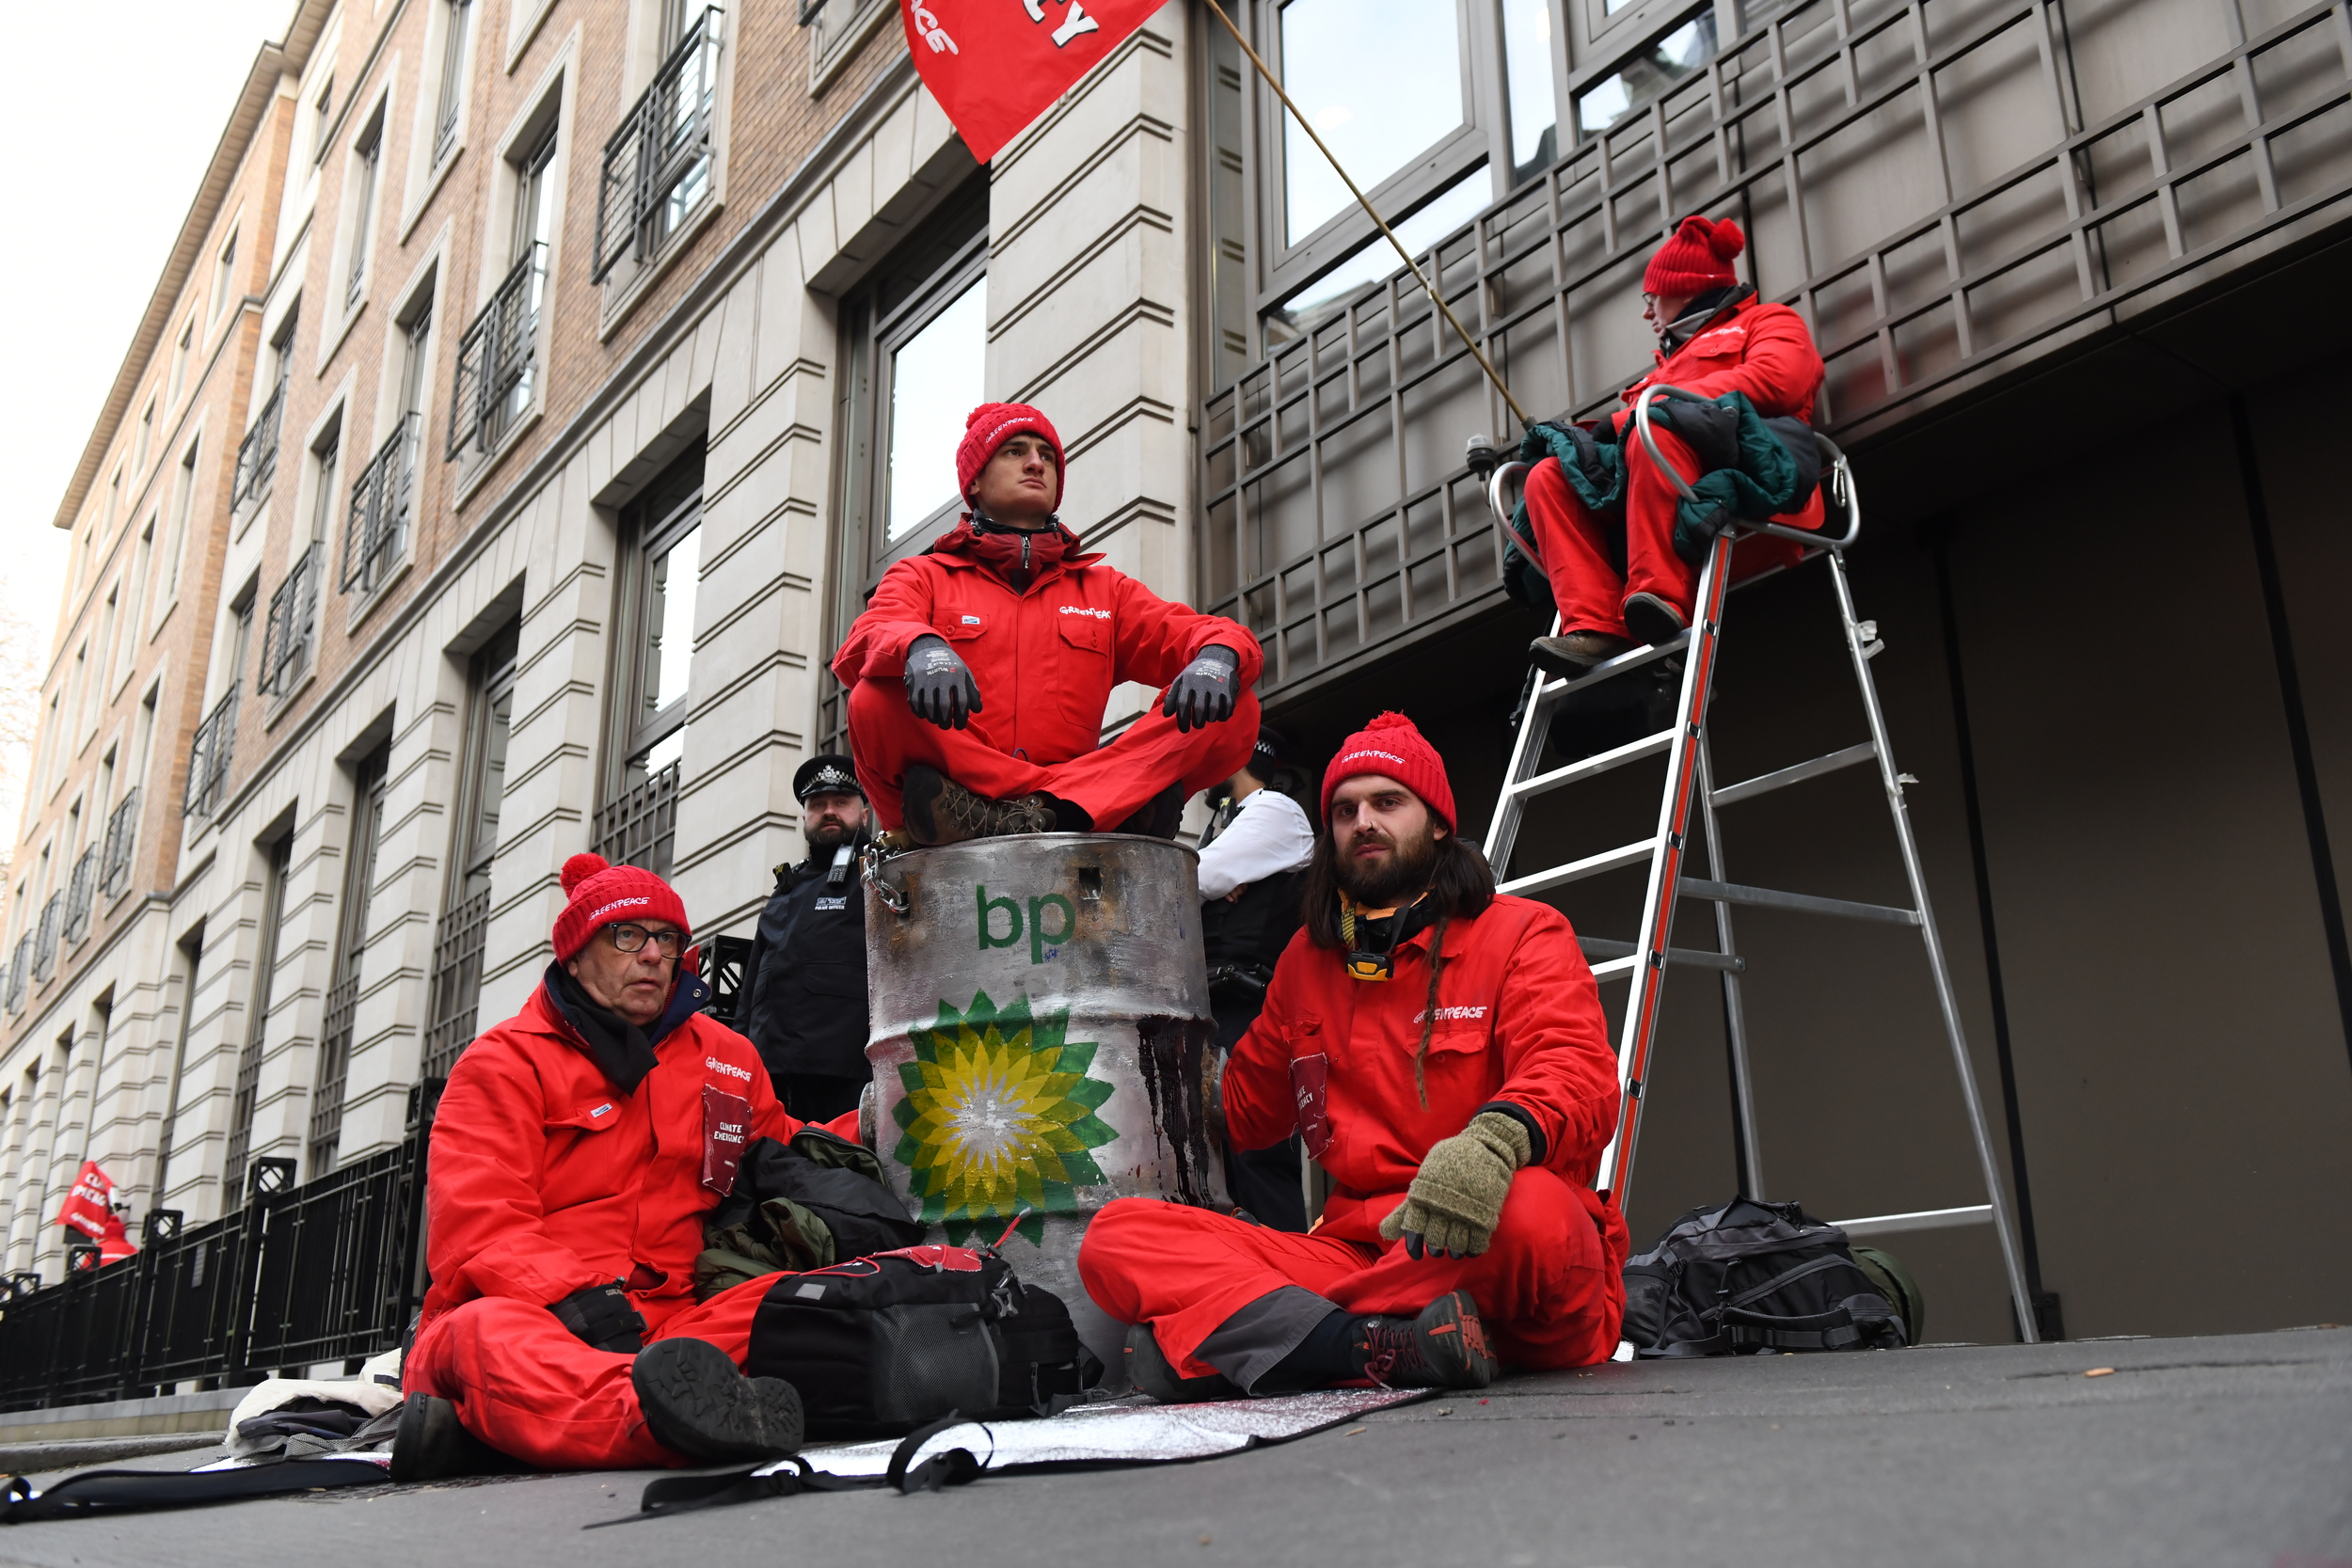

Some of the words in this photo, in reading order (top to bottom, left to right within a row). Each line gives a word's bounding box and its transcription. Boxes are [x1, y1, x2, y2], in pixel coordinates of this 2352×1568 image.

[911, 0, 959, 55] CE
[985, 417, 1035, 443] GREENPEACE
[1341, 749, 1406, 764] GREENPEACE
[589, 896, 651, 921] GREENPEACE
[977, 884, 1075, 965] bp
[1413, 1006, 1487, 1024] GENPEACE
[706, 1055, 752, 1082] GENPEACE
